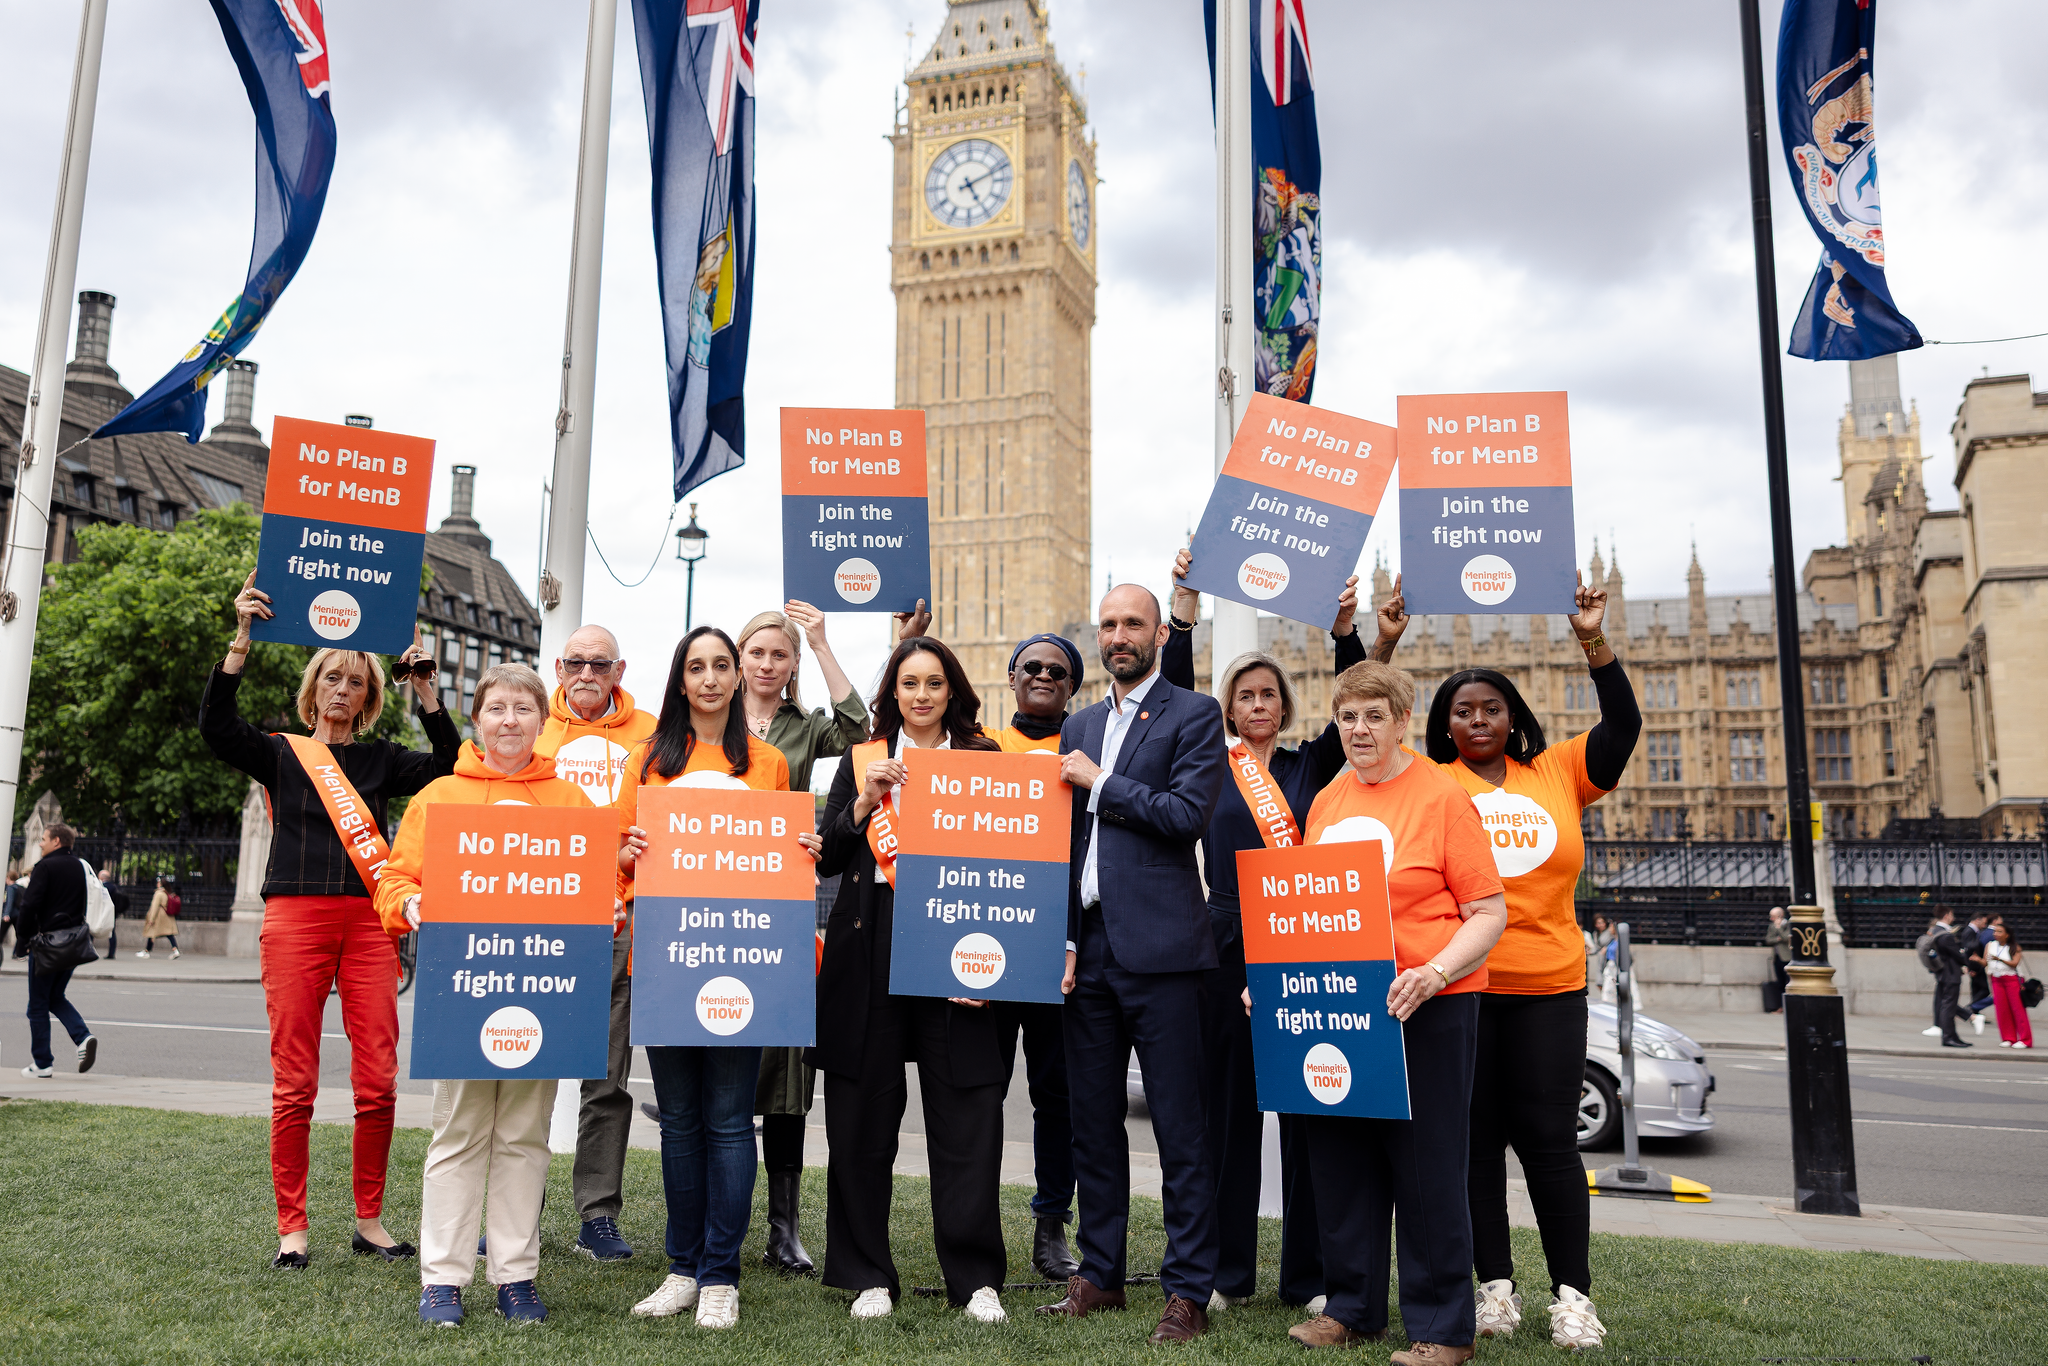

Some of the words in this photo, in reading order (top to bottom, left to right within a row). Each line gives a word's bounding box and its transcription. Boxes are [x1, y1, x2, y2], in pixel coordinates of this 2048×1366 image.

[1427, 417, 1458, 434] No
[1466, 415, 1517, 433] Plan
[1525, 414, 1540, 432] B
[806, 428, 833, 445] No
[840, 429, 883, 446] Plan
[889, 430, 902, 446] B
[1267, 418, 1297, 439] No
[1301, 427, 1350, 454] Plan
[1355, 441, 1372, 459] B
[299, 443, 330, 464] No
[337, 448, 385, 473] Plan
[392, 457, 407, 475] B
[809, 456, 839, 474] for
[845, 458, 900, 475] MenB
[1431, 447, 1465, 465] for
[1472, 445, 1538, 464] MenB
[1260, 446, 1292, 467] for
[1295, 455, 1358, 486] MenB
[299, 475, 332, 496] for
[338, 480, 400, 506] MenB
[818, 503, 854, 523] Join
[860, 504, 892, 520] the
[1247, 492, 1289, 516] Join
[1295, 506, 1329, 528] the
[1442, 496, 1484, 517] Join
[1491, 496, 1529, 513] the
[300, 527, 342, 549] Join
[349, 534, 384, 554] the
[810, 531, 857, 551] fight
[863, 535, 903, 548] now
[1230, 516, 1281, 544] fight
[1284, 534, 1330, 557] now
[1432, 526, 1487, 548] fight
[1494, 529, 1542, 543] now
[288, 555, 341, 580] fight
[346, 567, 392, 585] now
[838, 573, 877, 582] Meningitis
[1244, 563, 1286, 581] Meningitis
[1465, 572, 1512, 580] Meningitis
[844, 582, 872, 591] now
[1246, 574, 1278, 590] now
[1472, 581, 1505, 591] now
[313, 605, 357, 617] Meningitis
[318, 615, 350, 628] now
[556, 757, 627, 771] Meningtis
[565, 770, 617, 787] now
[931, 774, 962, 795] No
[970, 776, 1020, 798] Plan
[1029, 779, 1044, 799] B
[315, 764, 377, 860] Meningitis
[932, 809, 966, 830] for
[973, 811, 1039, 834] MenB
[1481, 811, 1548, 827] ningitis
[669, 813, 702, 834] No
[710, 814, 762, 836] Plan
[771, 817, 786, 837] B
[459, 832, 494, 855] No
[503, 833, 560, 856] Plan
[569, 835, 586, 857] B
[671, 848, 707, 870] for
[715, 850, 782, 872] MenB
[460, 870, 499, 893] for
[507, 872, 581, 895] MenB
[937, 866, 980, 889] Join
[988, 868, 1025, 889] the
[1262, 876, 1289, 897] No
[1294, 872, 1340, 895] Plan
[1345, 870, 1360, 892] B
[679, 907, 724, 932] Join
[731, 908, 771, 929] the
[926, 898, 981, 923] fight
[988, 906, 1036, 923] now
[1268, 912, 1297, 934] for
[1302, 909, 1361, 933] MenB
[465, 933, 515, 960] Join
[523, 934, 565, 956] the
[667, 942, 726, 968] fight
[733, 948, 783, 964] now
[955, 951, 1002, 962] Meningitis
[961, 962, 995, 974] now
[452, 970, 515, 998] fight
[522, 976, 576, 993] now
[1282, 972, 1318, 998] Join
[1322, 971, 1357, 993] the
[701, 996, 749, 1007] Meningitis
[707, 1007, 742, 1019] now
[1275, 1008, 1323, 1035] fight
[1328, 1013, 1370, 1030] now
[486, 1027, 538, 1039] Meningitis
[493, 1039, 530, 1051] now
[1307, 1064, 1347, 1075] Meningitis
[1313, 1075, 1342, 1088] now
